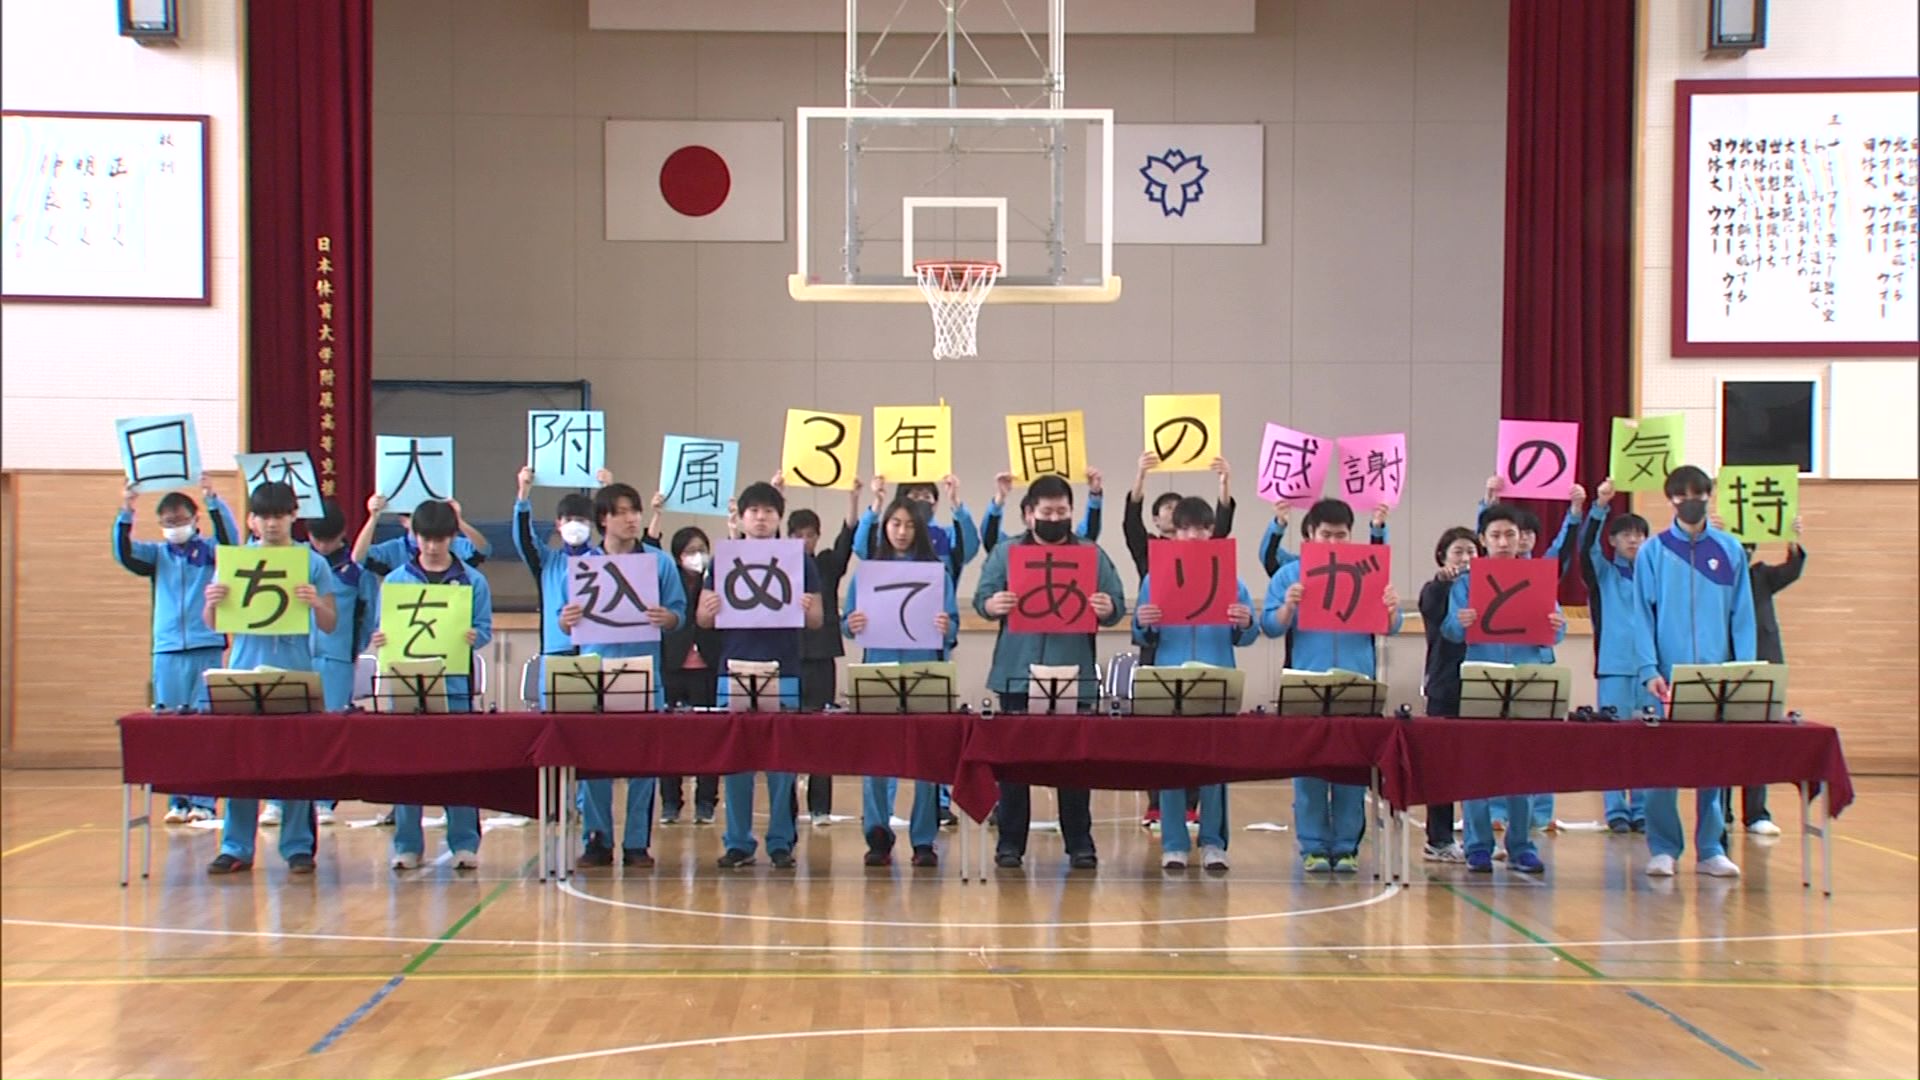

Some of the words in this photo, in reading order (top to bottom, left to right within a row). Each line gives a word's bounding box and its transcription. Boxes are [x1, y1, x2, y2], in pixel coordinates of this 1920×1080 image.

[127, 420, 189, 483] 日
[385, 440, 447, 500] 大
[531, 414, 602, 476] 附
[793, 417, 845, 487] 3
[885, 417, 936, 476] 年
[1018, 418, 1069, 481] 間
[1153, 416, 1208, 464] の
[1260, 439, 1318, 499] 感
[1344, 446, 1403, 494] 謝
[1508, 440, 1567, 487] の
[1622, 432, 1670, 482] 気
[663, 443, 723, 507] 属
[1729, 476, 1787, 536] 持
[235, 560, 289, 629] ち
[575, 561, 653, 627] 込
[724, 556, 791, 611] め
[874, 582, 931, 642] て
[1018, 552, 1087, 625] あ
[1306, 552, 1379, 623] が
[1480, 574, 1530, 635] と
[397, 589, 448, 659] を
